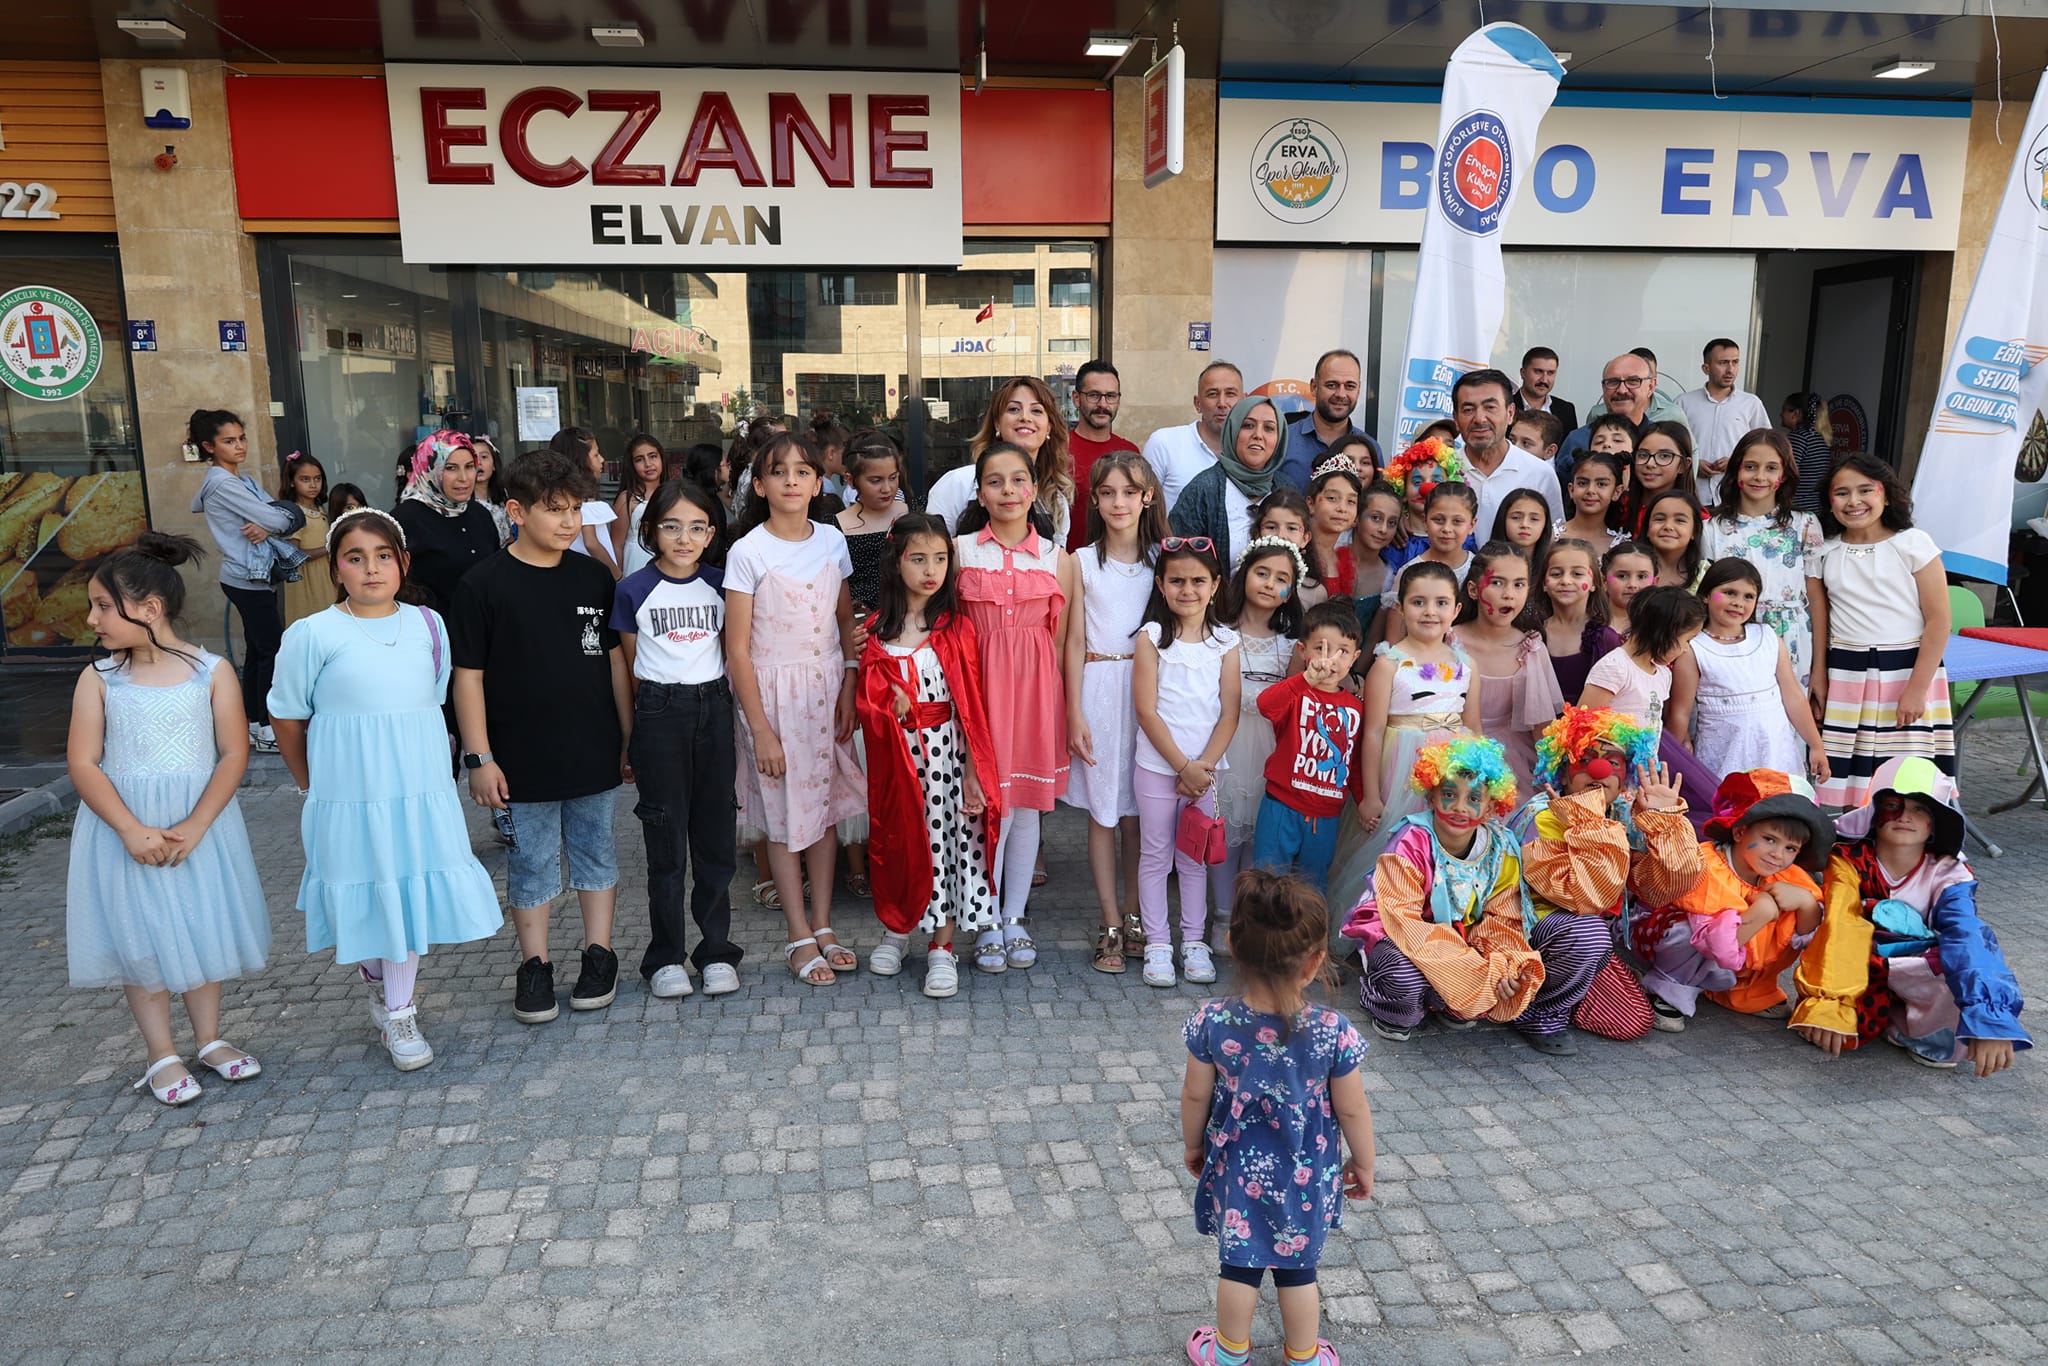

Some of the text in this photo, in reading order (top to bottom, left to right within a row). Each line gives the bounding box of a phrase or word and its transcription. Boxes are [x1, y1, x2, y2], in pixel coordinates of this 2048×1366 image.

[420, 86, 933, 189] ECZANE
[1281, 145, 1318, 158] ERVA
[1256, 160, 1340, 186] Spor Okulları
[1380, 141, 1933, 219] BO ERVA
[1442, 171, 1465, 217] BÜNYAN
[590, 204, 782, 246] ELVAN
[40, 290, 51, 299] VE
[54, 293, 82, 318] TURİZM
[632, 327, 704, 356] AÇIK
[41, 388, 62, 397] 1992
[1275, 383, 1301, 394] T.C.
[648, 604, 720, 638] BROOKLYN
[667, 631, 709, 643] New York
